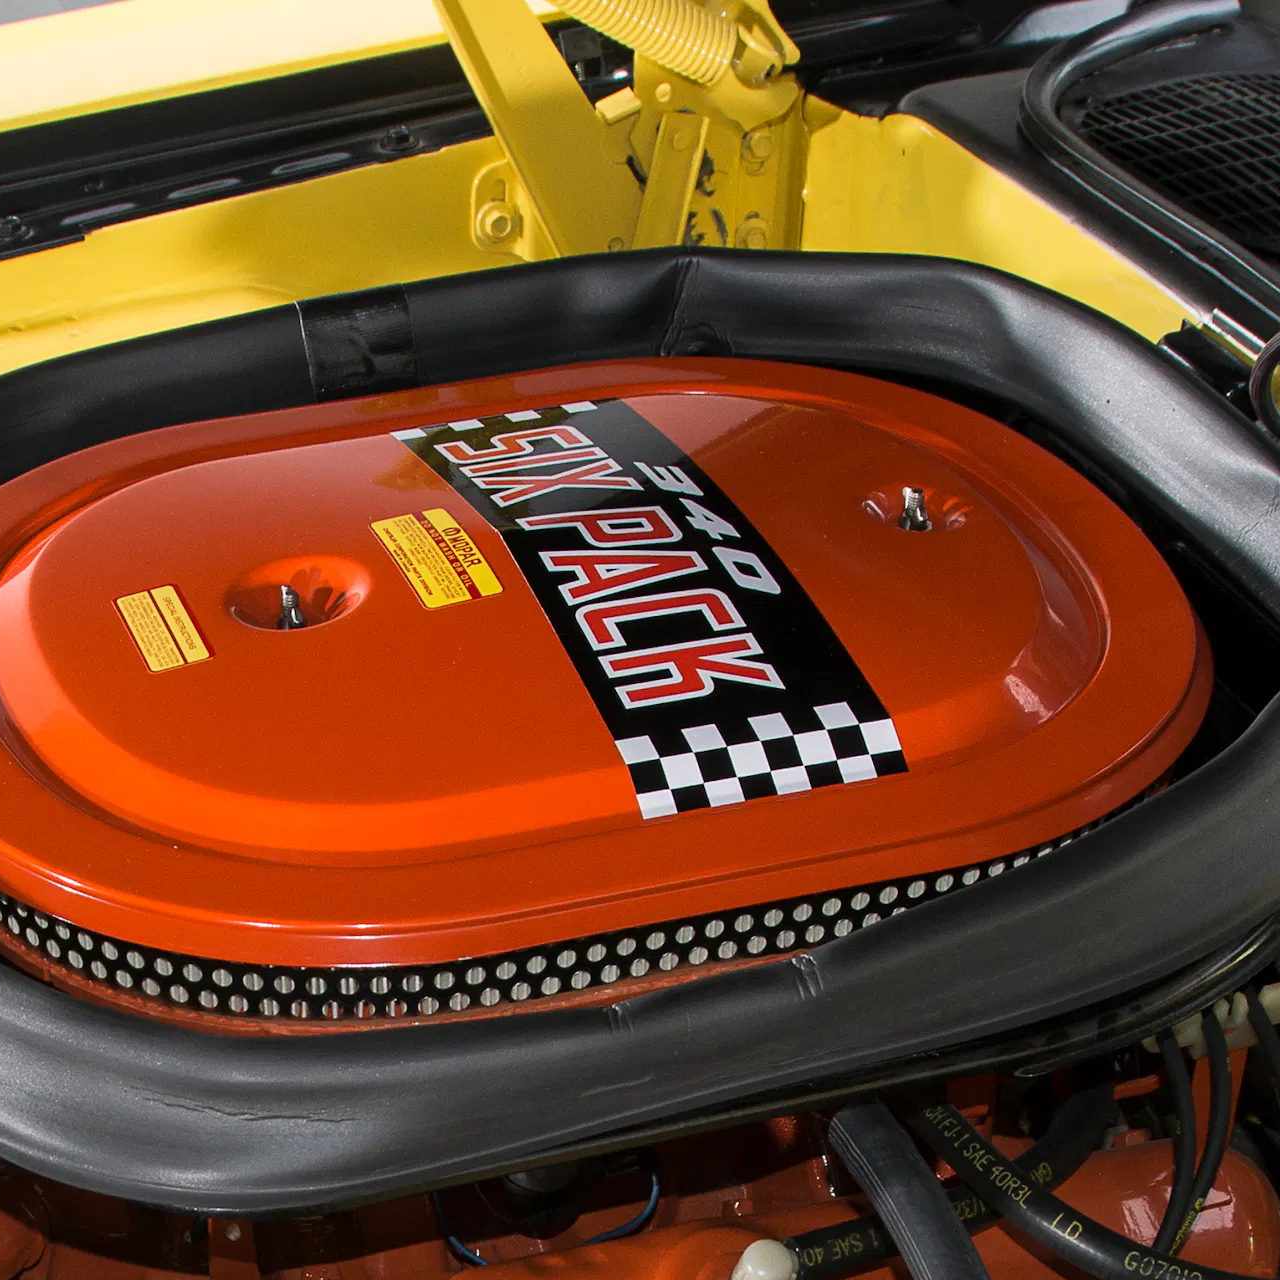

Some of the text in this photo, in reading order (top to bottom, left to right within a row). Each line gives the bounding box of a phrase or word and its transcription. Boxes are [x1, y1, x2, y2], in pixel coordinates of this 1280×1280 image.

[426, 528, 442, 541] NOT
[436, 541, 456, 560] WASH
[450, 561, 465, 573] OR
[458, 573, 475, 587] OIL
[446, 535, 485, 568] MOPAR
[634, 461, 782, 595] 340
[434, 426, 787, 710] SIX PACK
[161, 596, 198, 650] SPECIAL INSTRUCTIONS
[962, 1142, 996, 1173] SAE
[990, 1165, 1034, 1210] 40R3L
[828, 1232, 864, 1261] SAE
